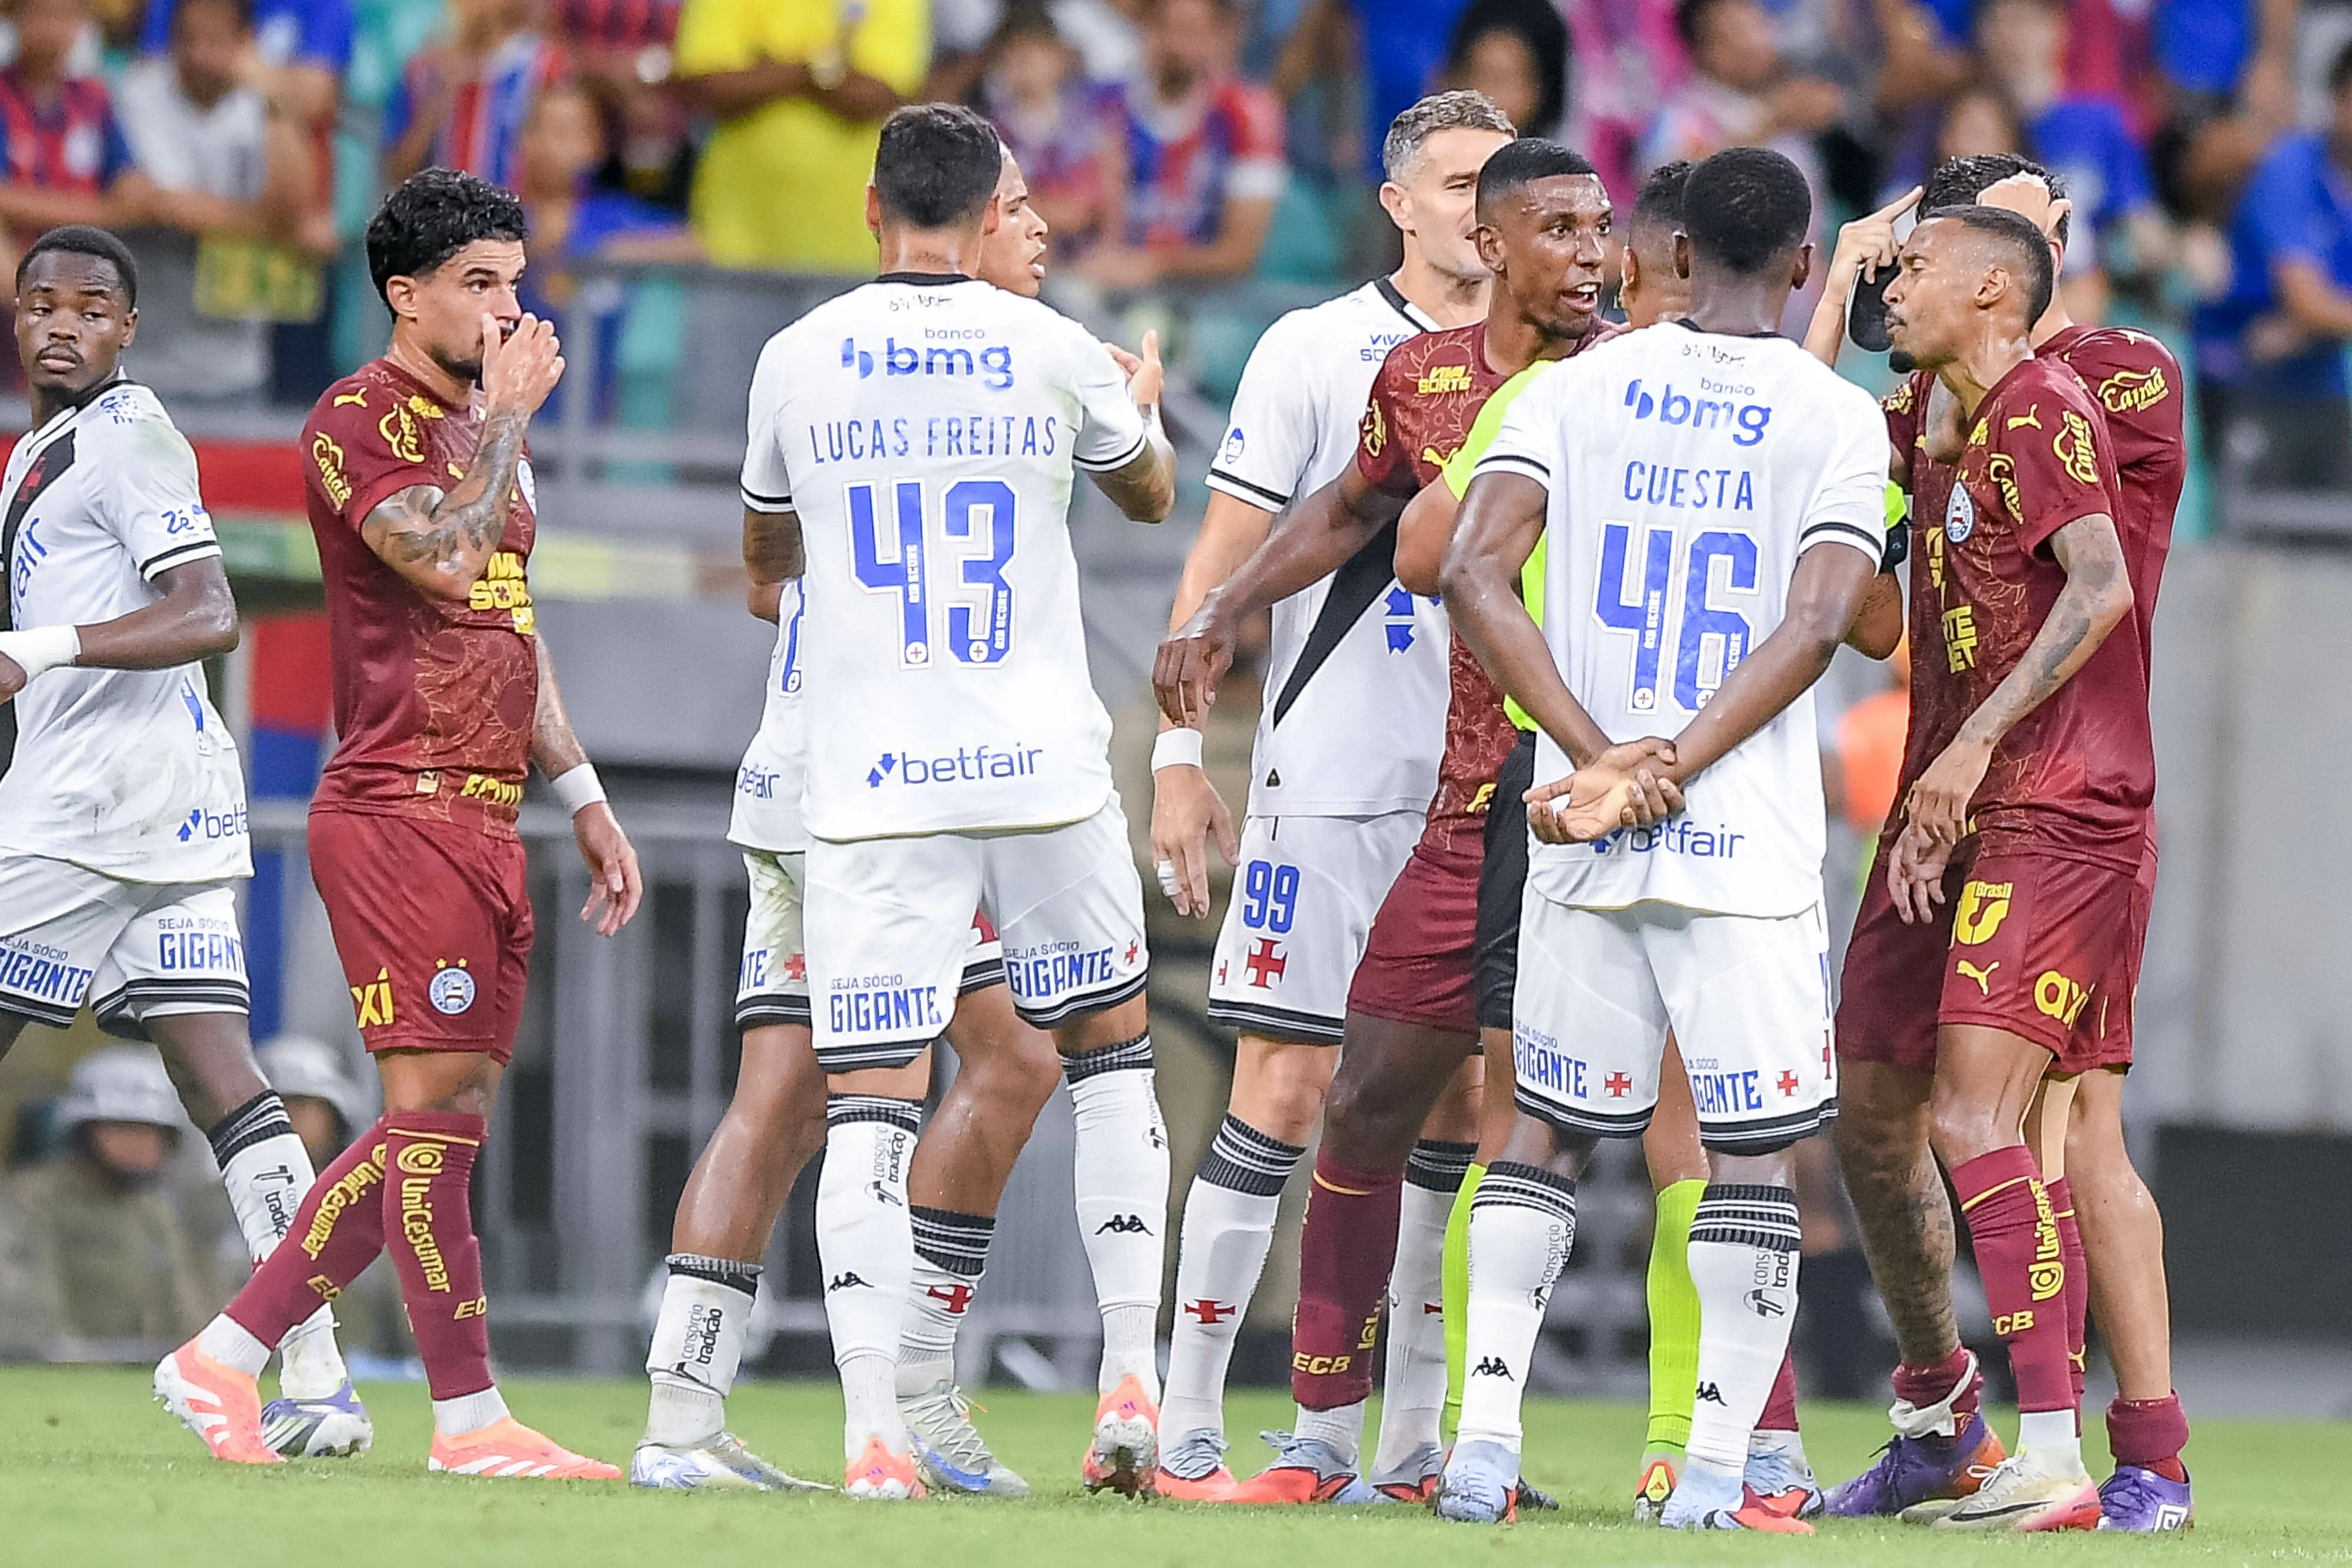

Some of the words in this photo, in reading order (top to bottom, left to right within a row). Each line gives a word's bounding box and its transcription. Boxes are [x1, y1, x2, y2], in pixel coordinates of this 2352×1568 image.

[924, 327, 985, 340] banco
[886, 337, 1014, 390] bmg
[1700, 377, 1755, 396] banco
[1660, 384, 1773, 446] bmg
[809, 418, 910, 464] LUCAS
[927, 416, 1057, 457] FREITAS
[1624, 460, 1754, 511] CUESTA
[846, 480, 1020, 665] 43
[1595, 522, 1759, 713] 46
[901, 743, 1044, 785] betfair
[1243, 860, 1300, 934] 99
[1976, 882, 2013, 899] Brasil
[158, 918, 193, 930] SEJA
[1003, 947, 1037, 960] SEJA
[1006, 946, 1114, 997] GIGANTE
[831, 977, 859, 989] SEJA
[830, 985, 943, 1033] GIGANTE
[1515, 1033, 1588, 1099] GIGANTE
[694, 1308, 723, 1365] tradição
[1293, 1352, 1351, 1375] ECB
